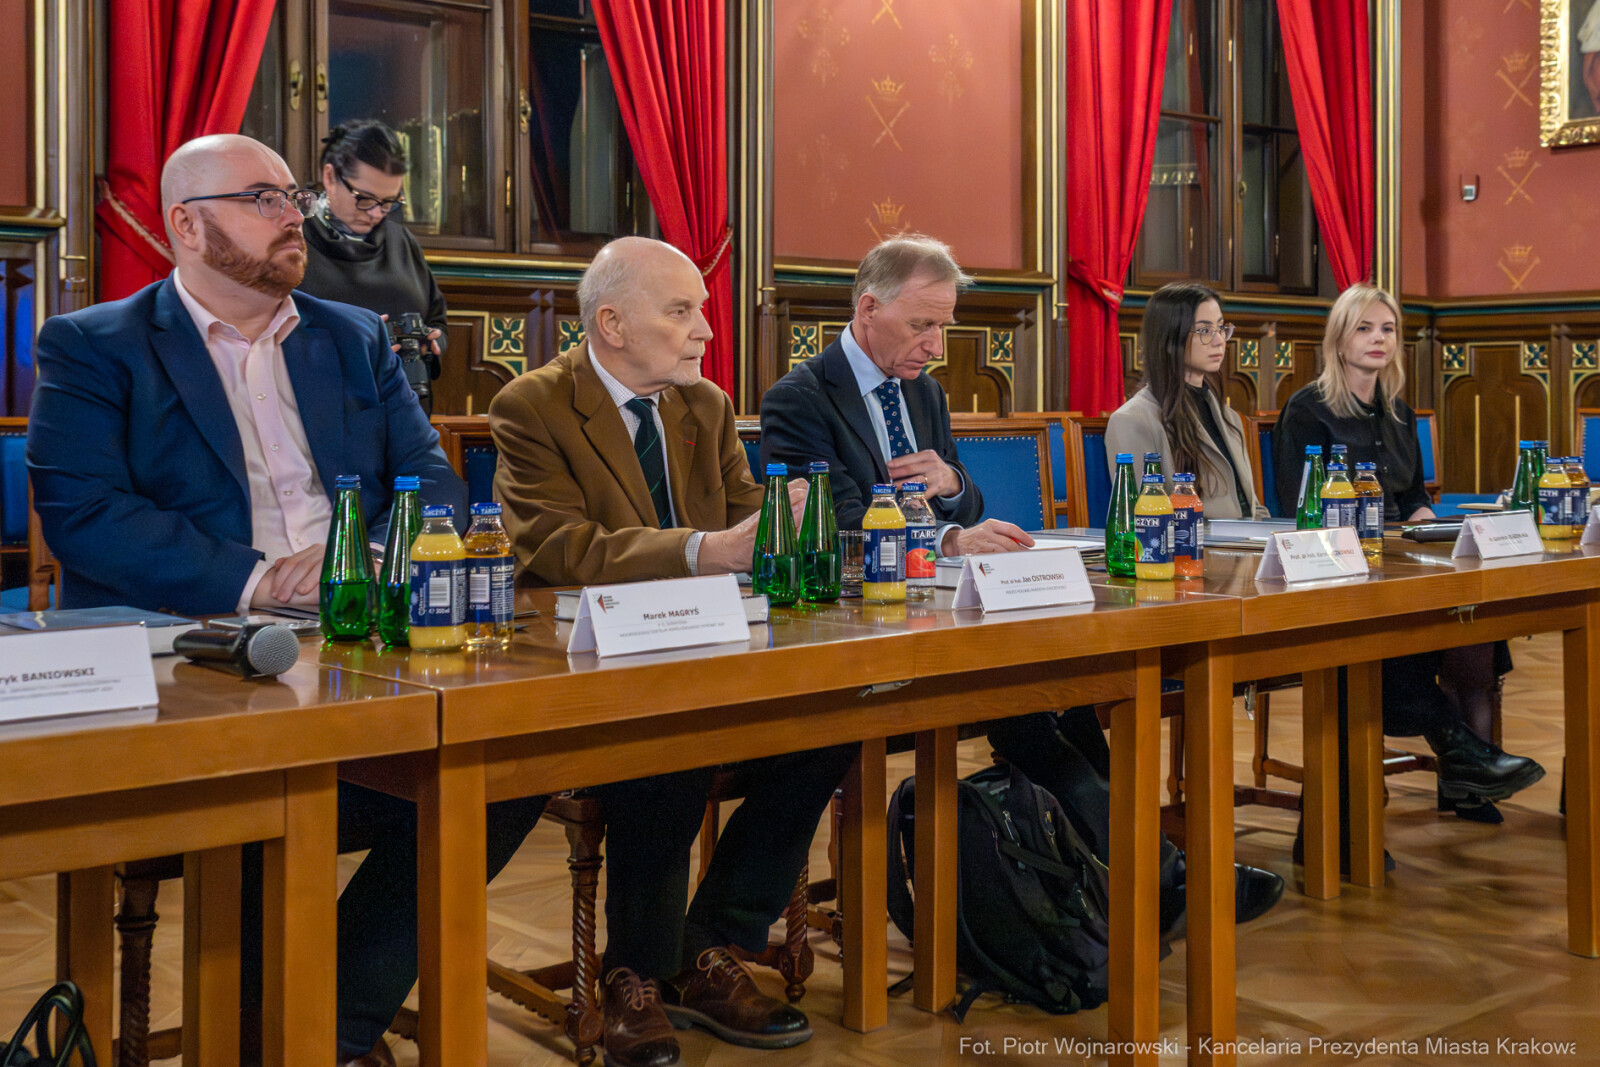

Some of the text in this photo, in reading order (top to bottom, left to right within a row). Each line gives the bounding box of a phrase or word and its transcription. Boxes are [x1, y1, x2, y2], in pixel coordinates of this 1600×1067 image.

[1031, 573, 1064, 582] OSTROWSKI
[643, 607, 700, 620] Marek MAGRYŚ
[22, 667, 95, 682] BANIOWSKI
